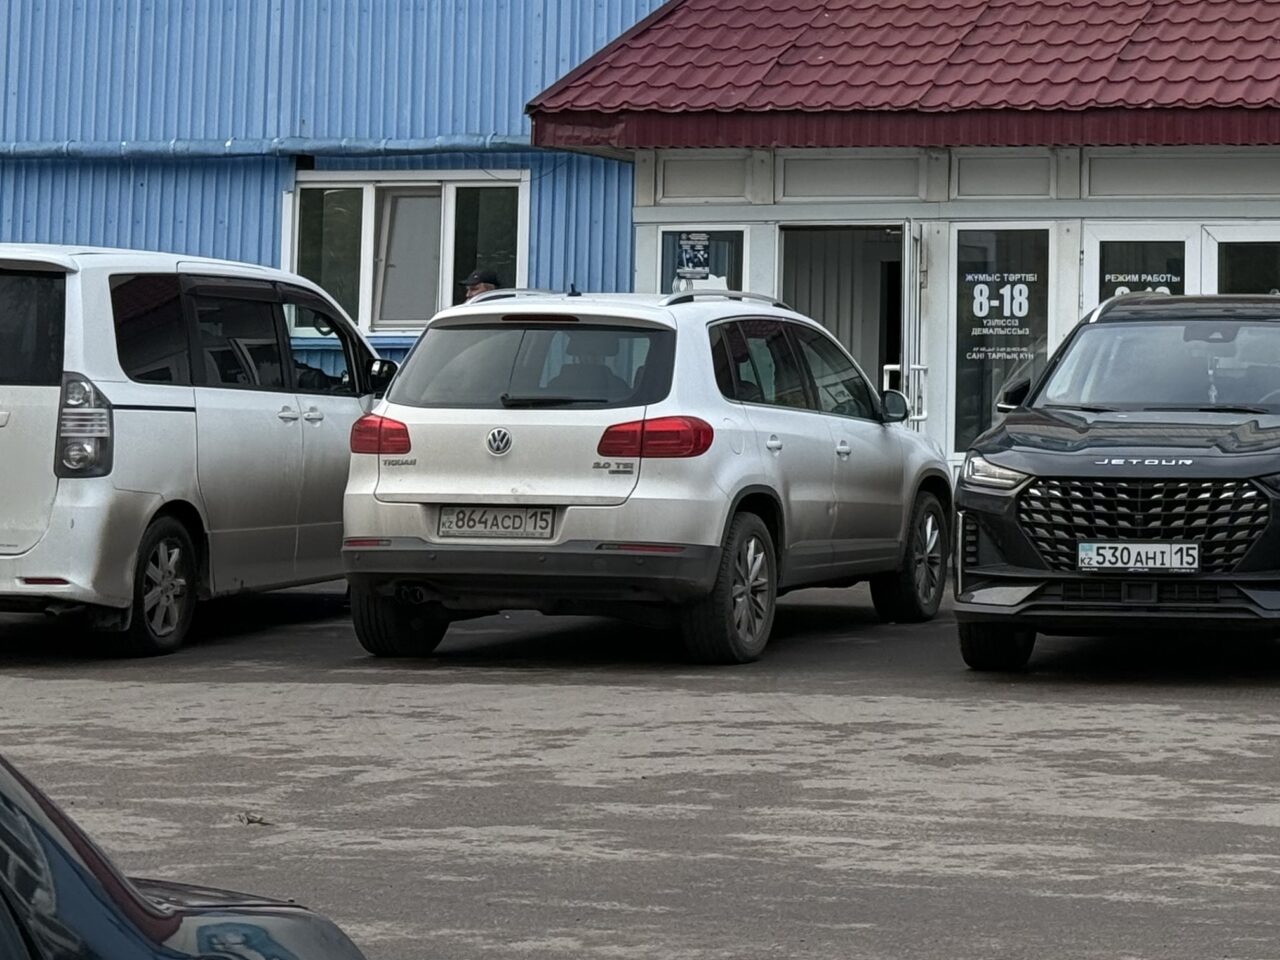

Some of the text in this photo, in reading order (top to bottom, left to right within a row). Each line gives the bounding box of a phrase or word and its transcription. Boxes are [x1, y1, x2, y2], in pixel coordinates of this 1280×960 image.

[1105, 274, 1181, 282] РЕЖИМ РАБОТЫ
[972, 283, 1029, 318] 8-18
[971, 327, 1030, 336] ДЕМАЛЫССЫЗ
[441, 511, 550, 530] KZ 864ACD 15
[1080, 556, 1093, 566] KZ
[1173, 546, 1197, 567] 15
